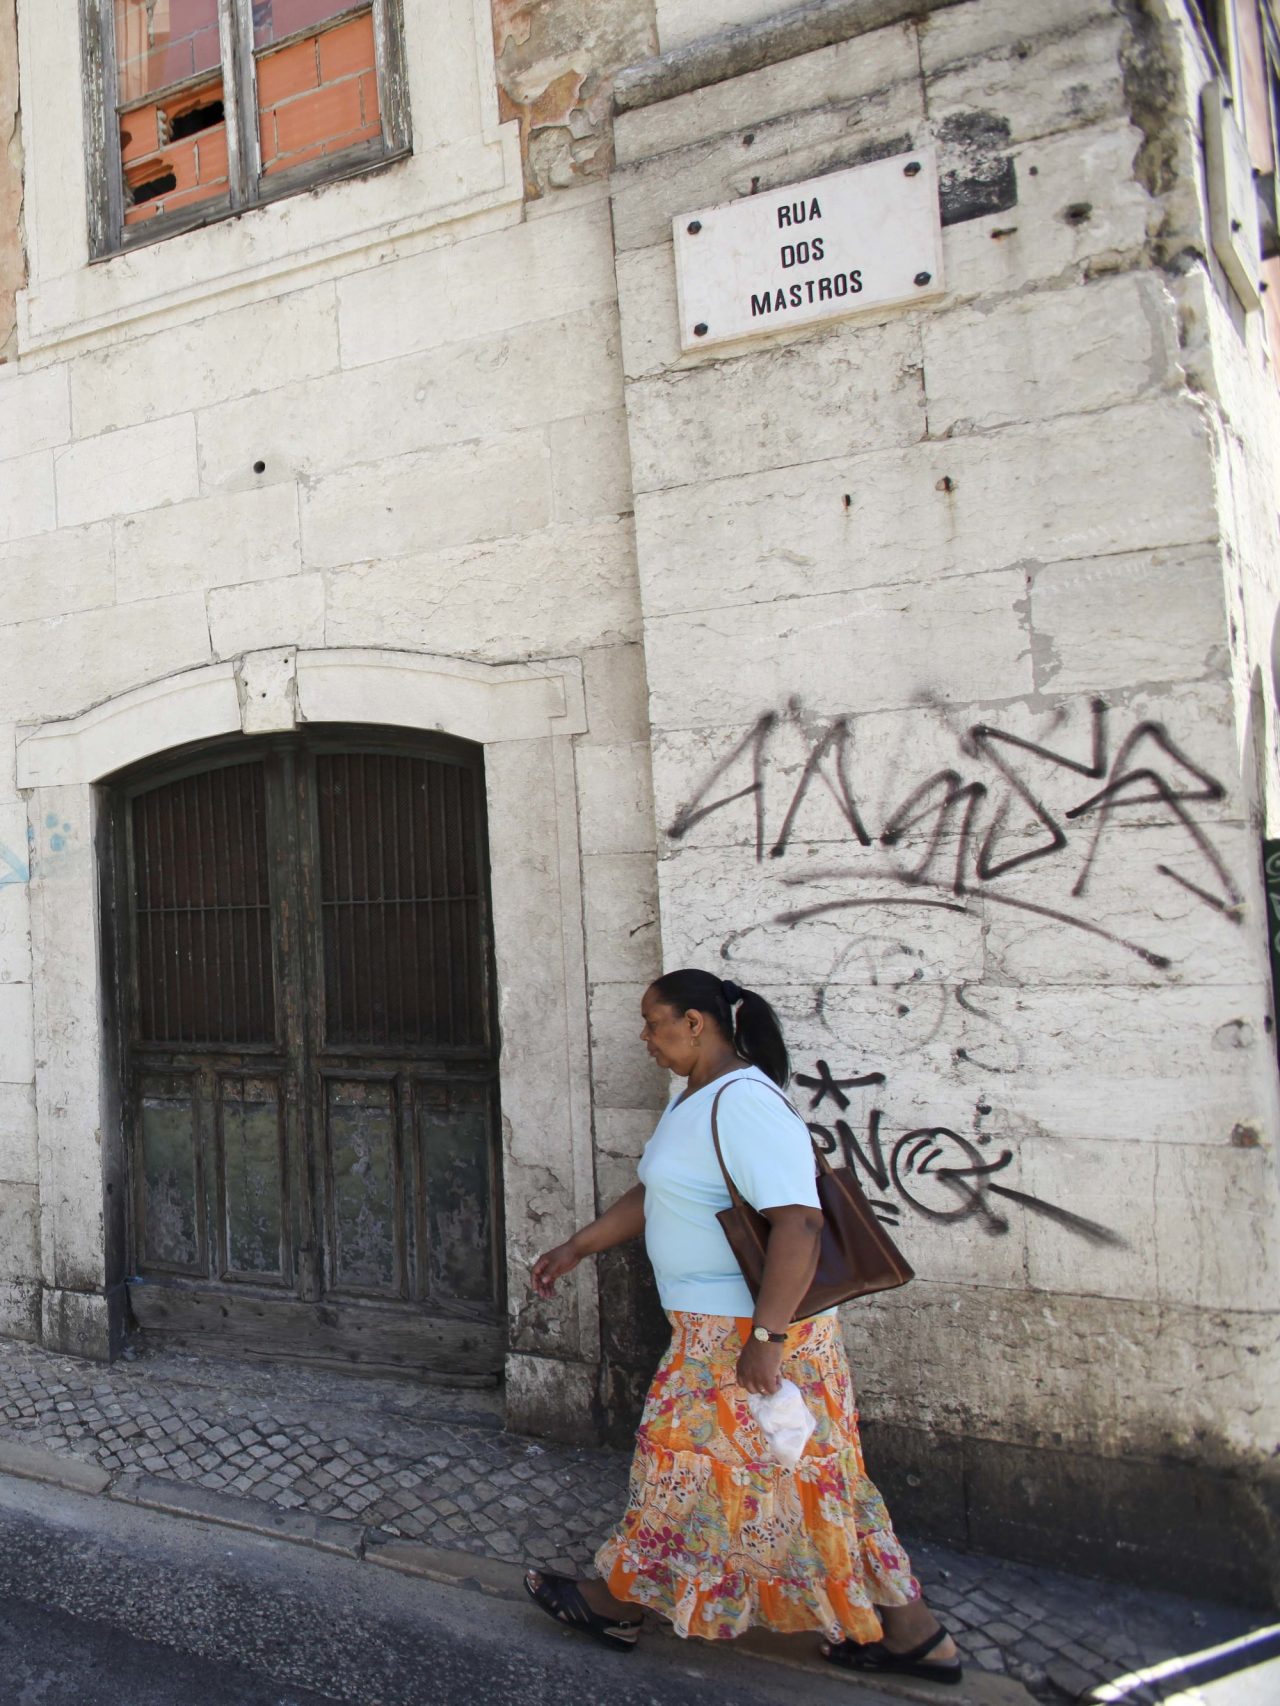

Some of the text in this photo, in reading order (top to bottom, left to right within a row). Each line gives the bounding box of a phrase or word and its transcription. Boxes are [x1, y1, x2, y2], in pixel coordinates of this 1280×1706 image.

[776, 197, 822, 229] RUA
[780, 237, 825, 269] DOS
[750, 269, 864, 317] MASTROS
